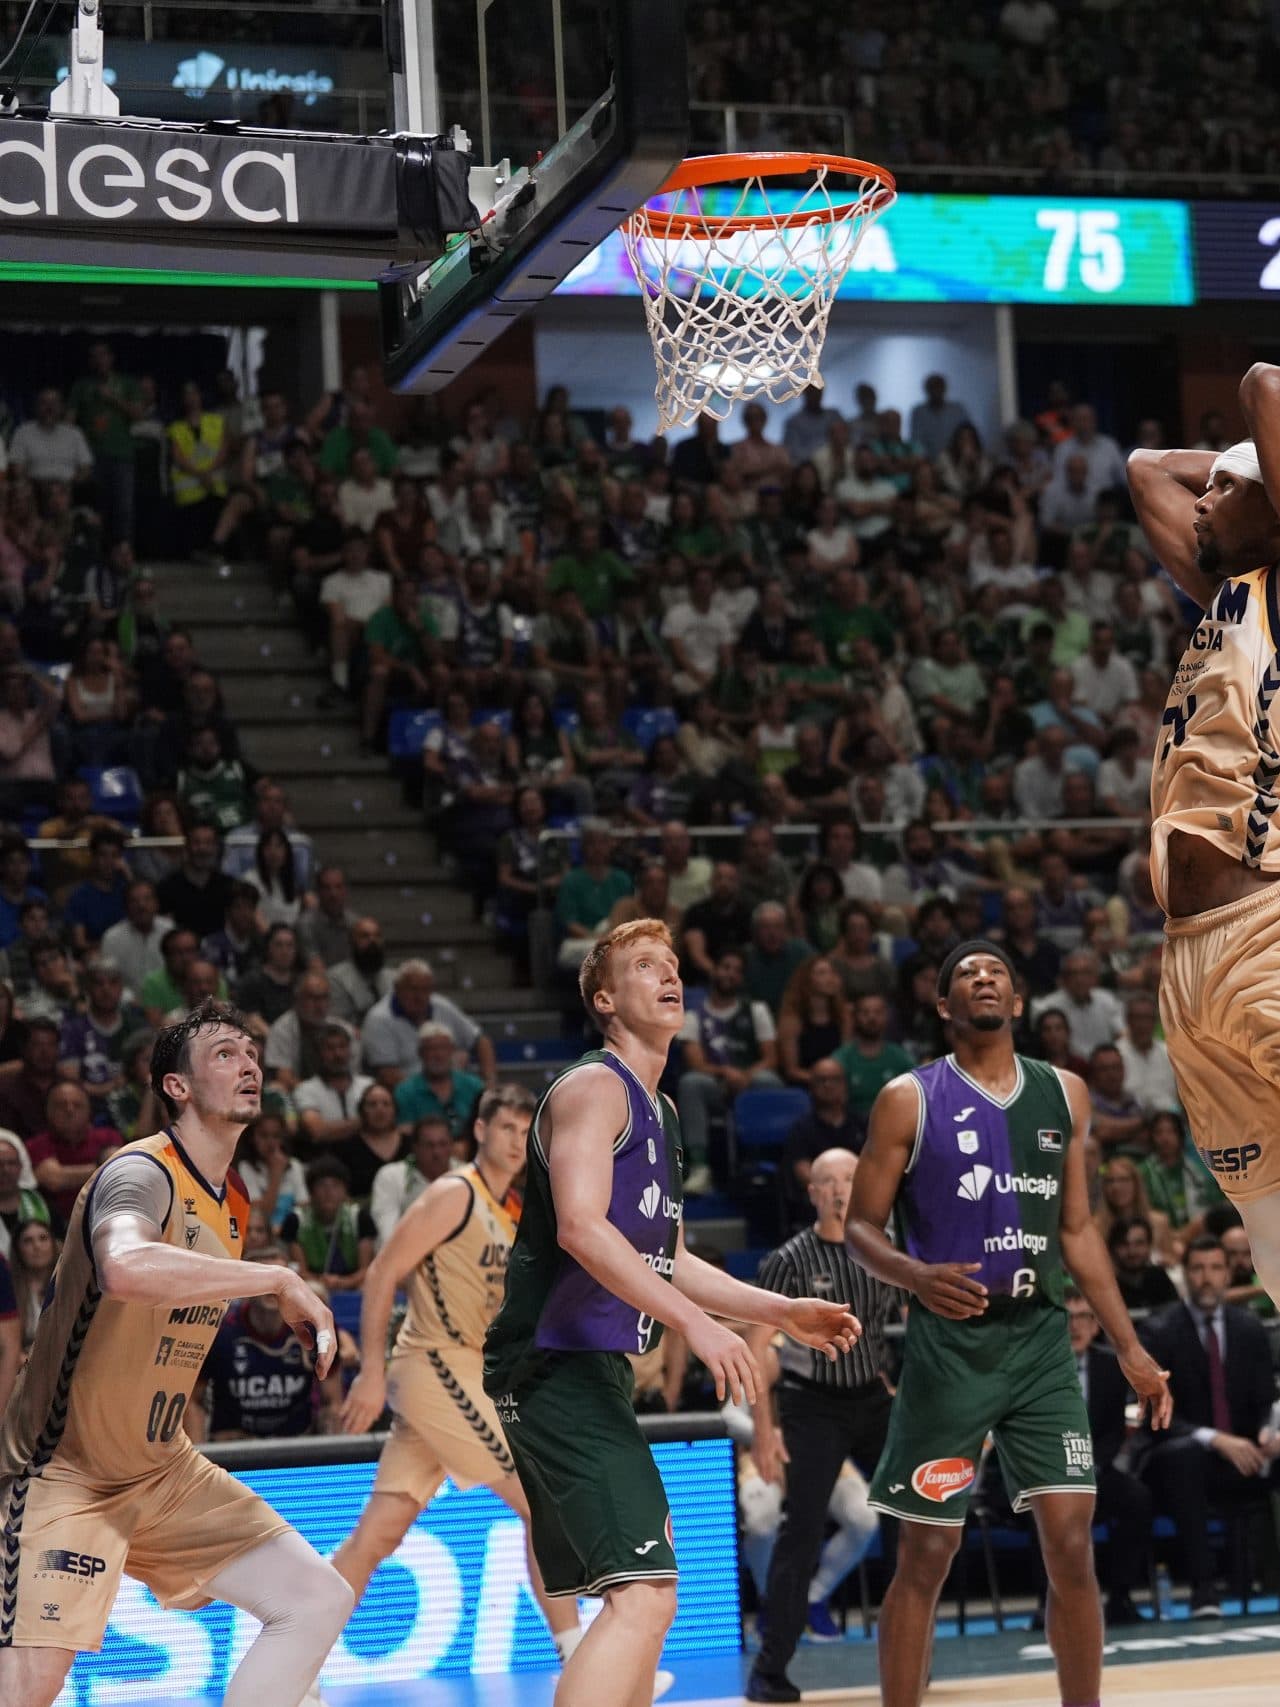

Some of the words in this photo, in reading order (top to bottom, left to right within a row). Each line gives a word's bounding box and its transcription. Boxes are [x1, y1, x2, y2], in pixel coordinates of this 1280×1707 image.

[1036, 209, 1124, 293] 75
[1209, 1143, 1261, 1172] ESP
[994, 1172, 1059, 1200] Unicaja
[984, 1226, 1048, 1256] málaga
[168, 1305, 223, 1329] MURCI
[227, 1373, 306, 1399] UCAM
[147, 1391, 187, 1443] 00
[59, 1550, 106, 1579] ESP
